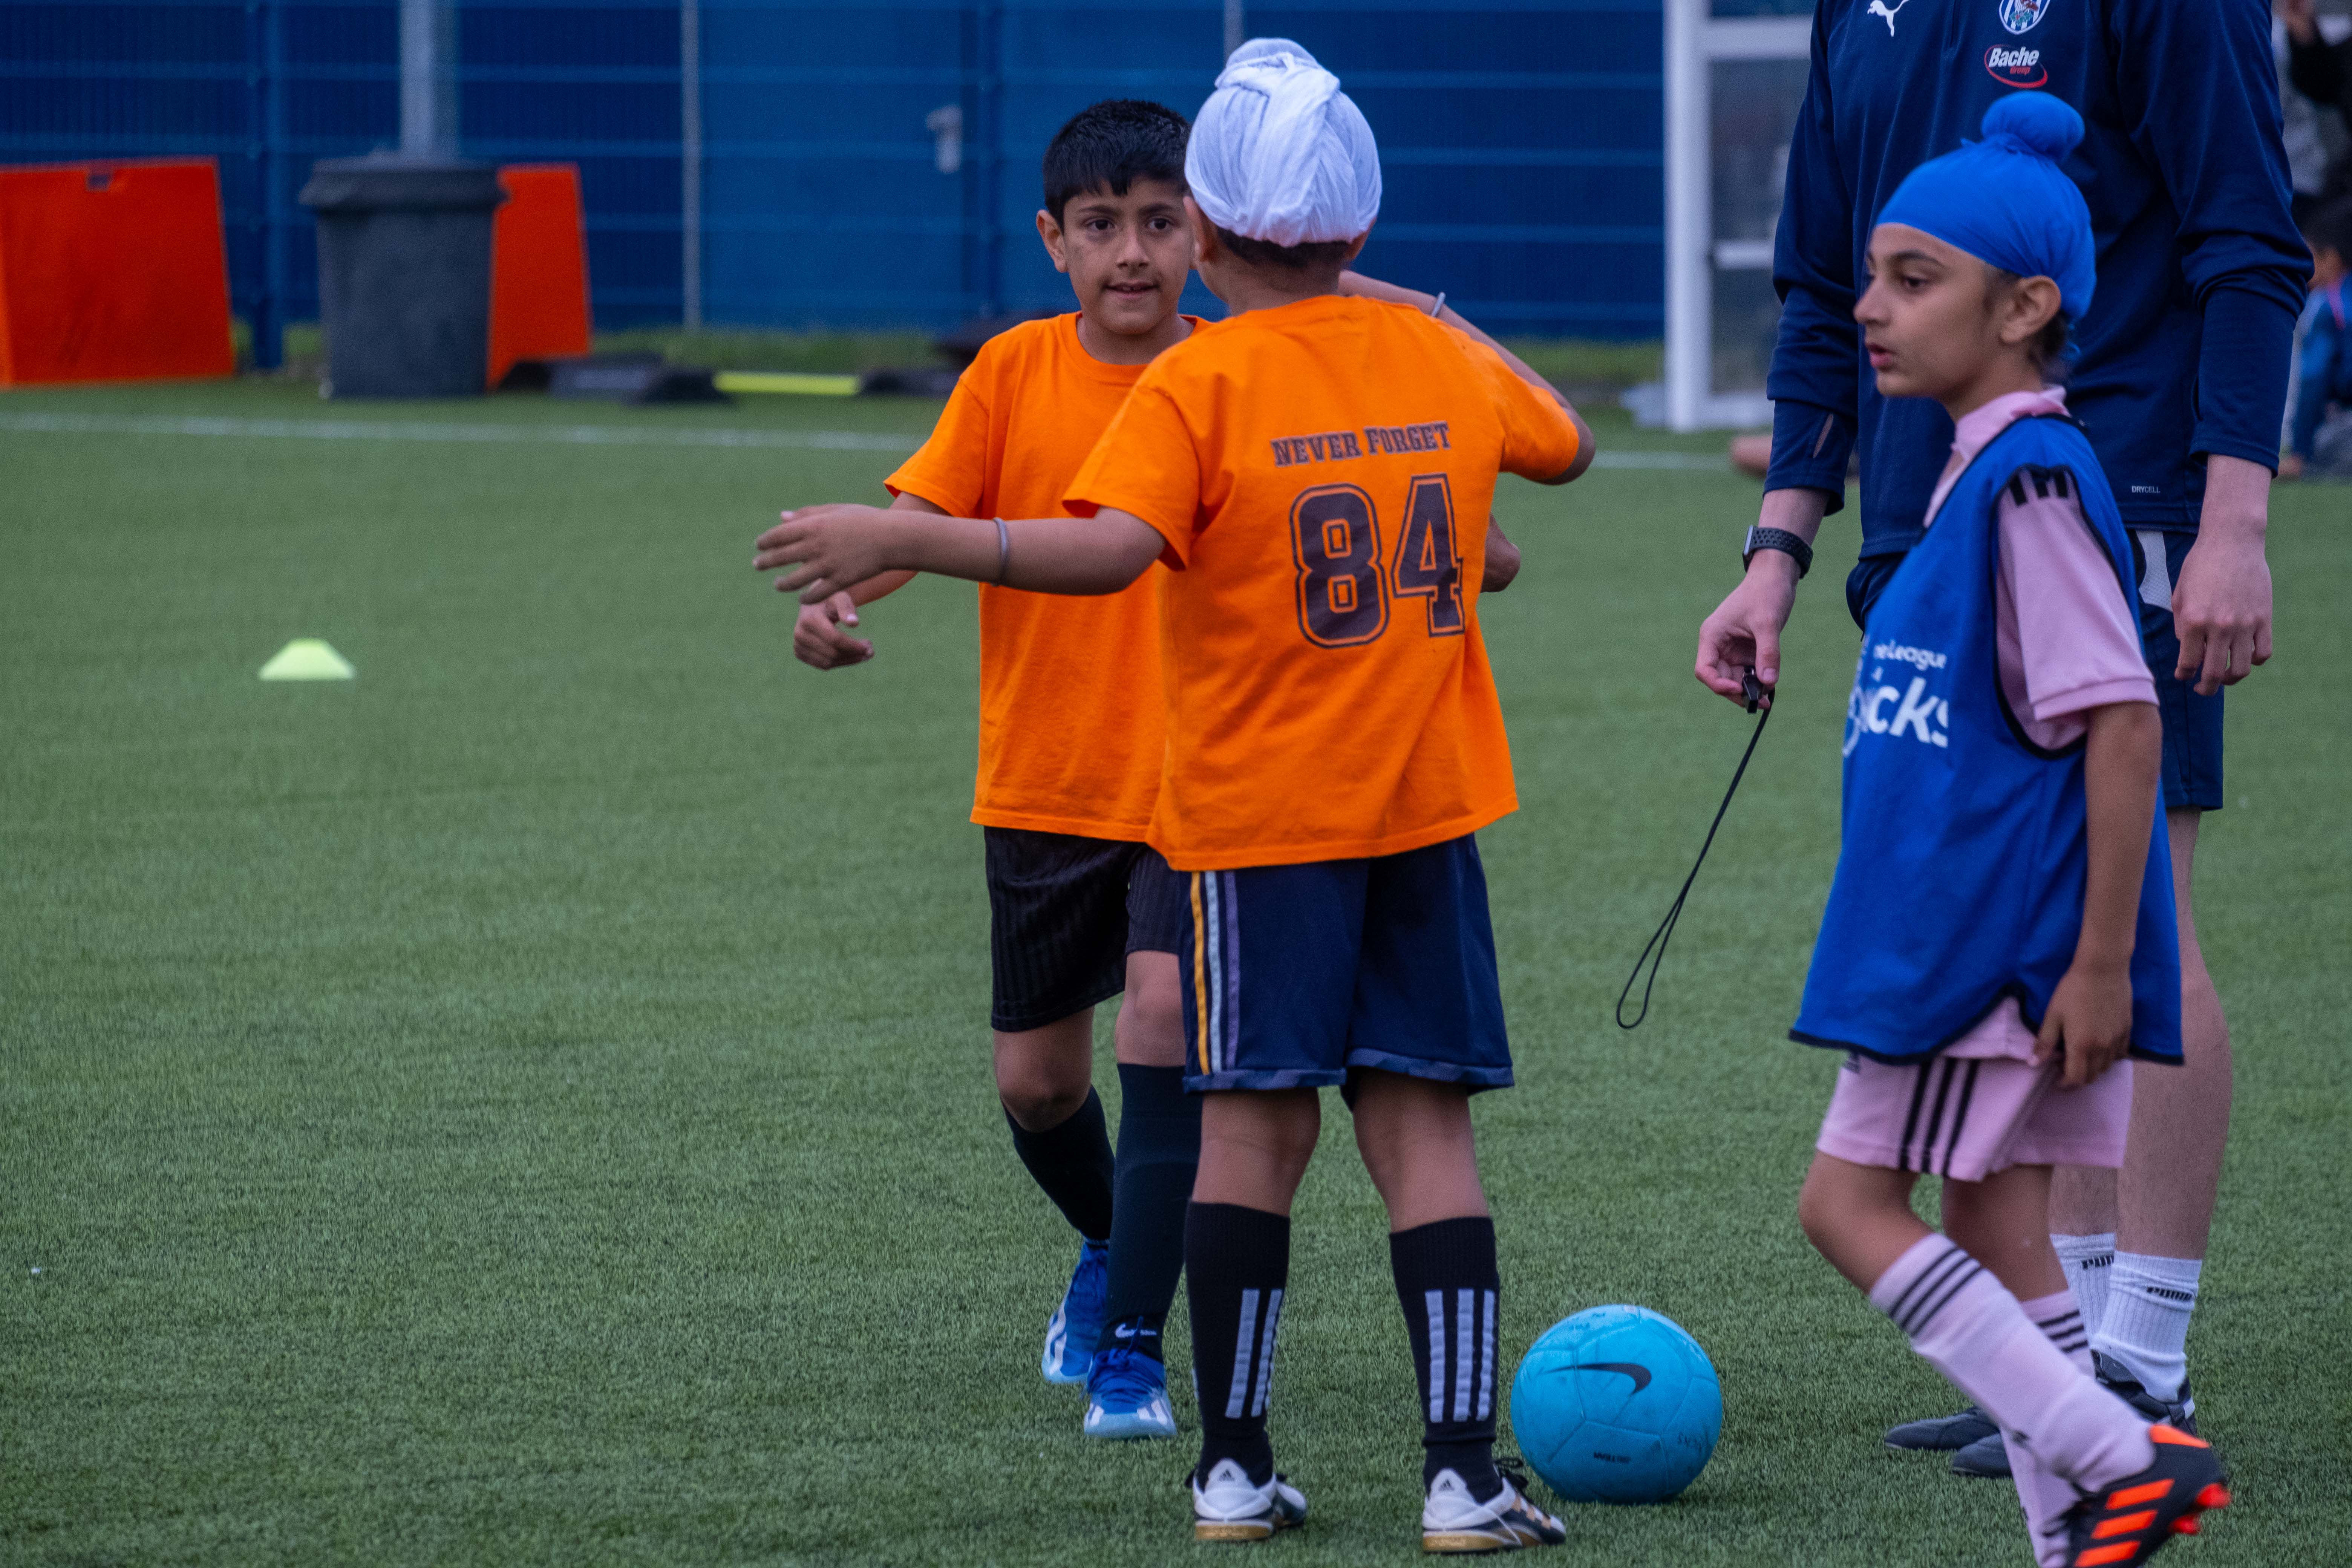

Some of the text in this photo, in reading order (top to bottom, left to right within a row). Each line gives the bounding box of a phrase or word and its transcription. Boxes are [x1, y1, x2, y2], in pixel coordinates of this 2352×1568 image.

[1989, 46, 2039, 67] Bache
[1270, 421, 1452, 467] NEVER FORGET
[2132, 485, 2161, 494] DRYCELL
[1289, 472, 1465, 649] 84
